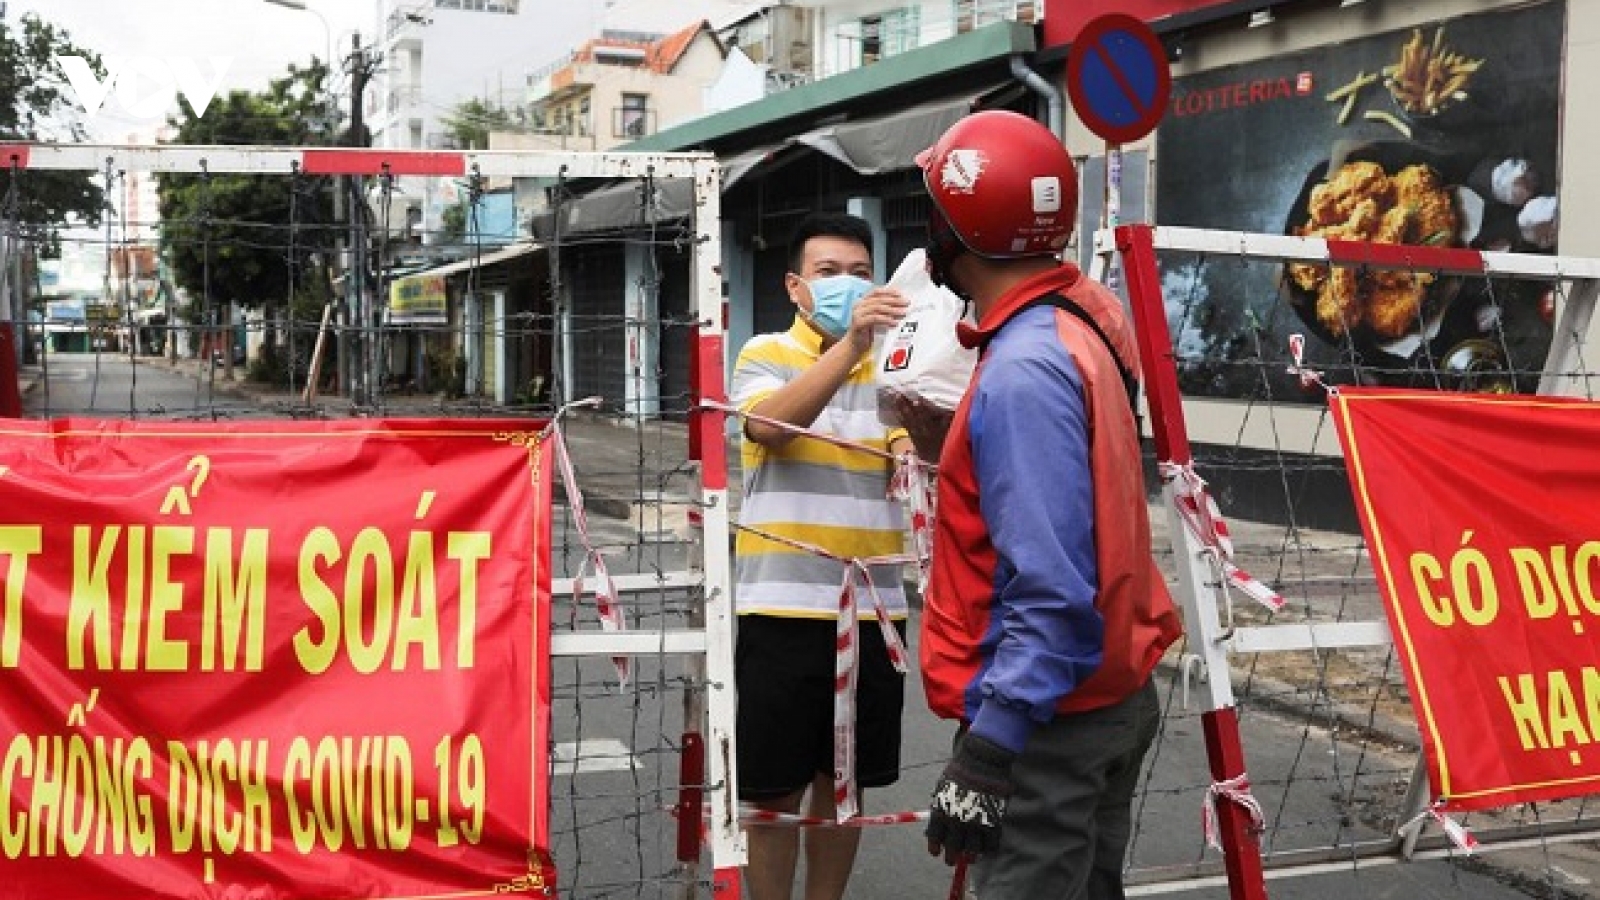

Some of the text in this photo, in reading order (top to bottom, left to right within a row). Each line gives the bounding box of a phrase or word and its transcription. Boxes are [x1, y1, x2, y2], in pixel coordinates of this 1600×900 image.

[1173, 77, 1291, 117] LOTTERIA
[66, 455, 270, 672] KIỂM
[292, 490, 492, 675] SOÁT
[1410, 530, 1499, 627] CÓ
[1, 689, 486, 884] CHỐNG DỊCH COVID-19
